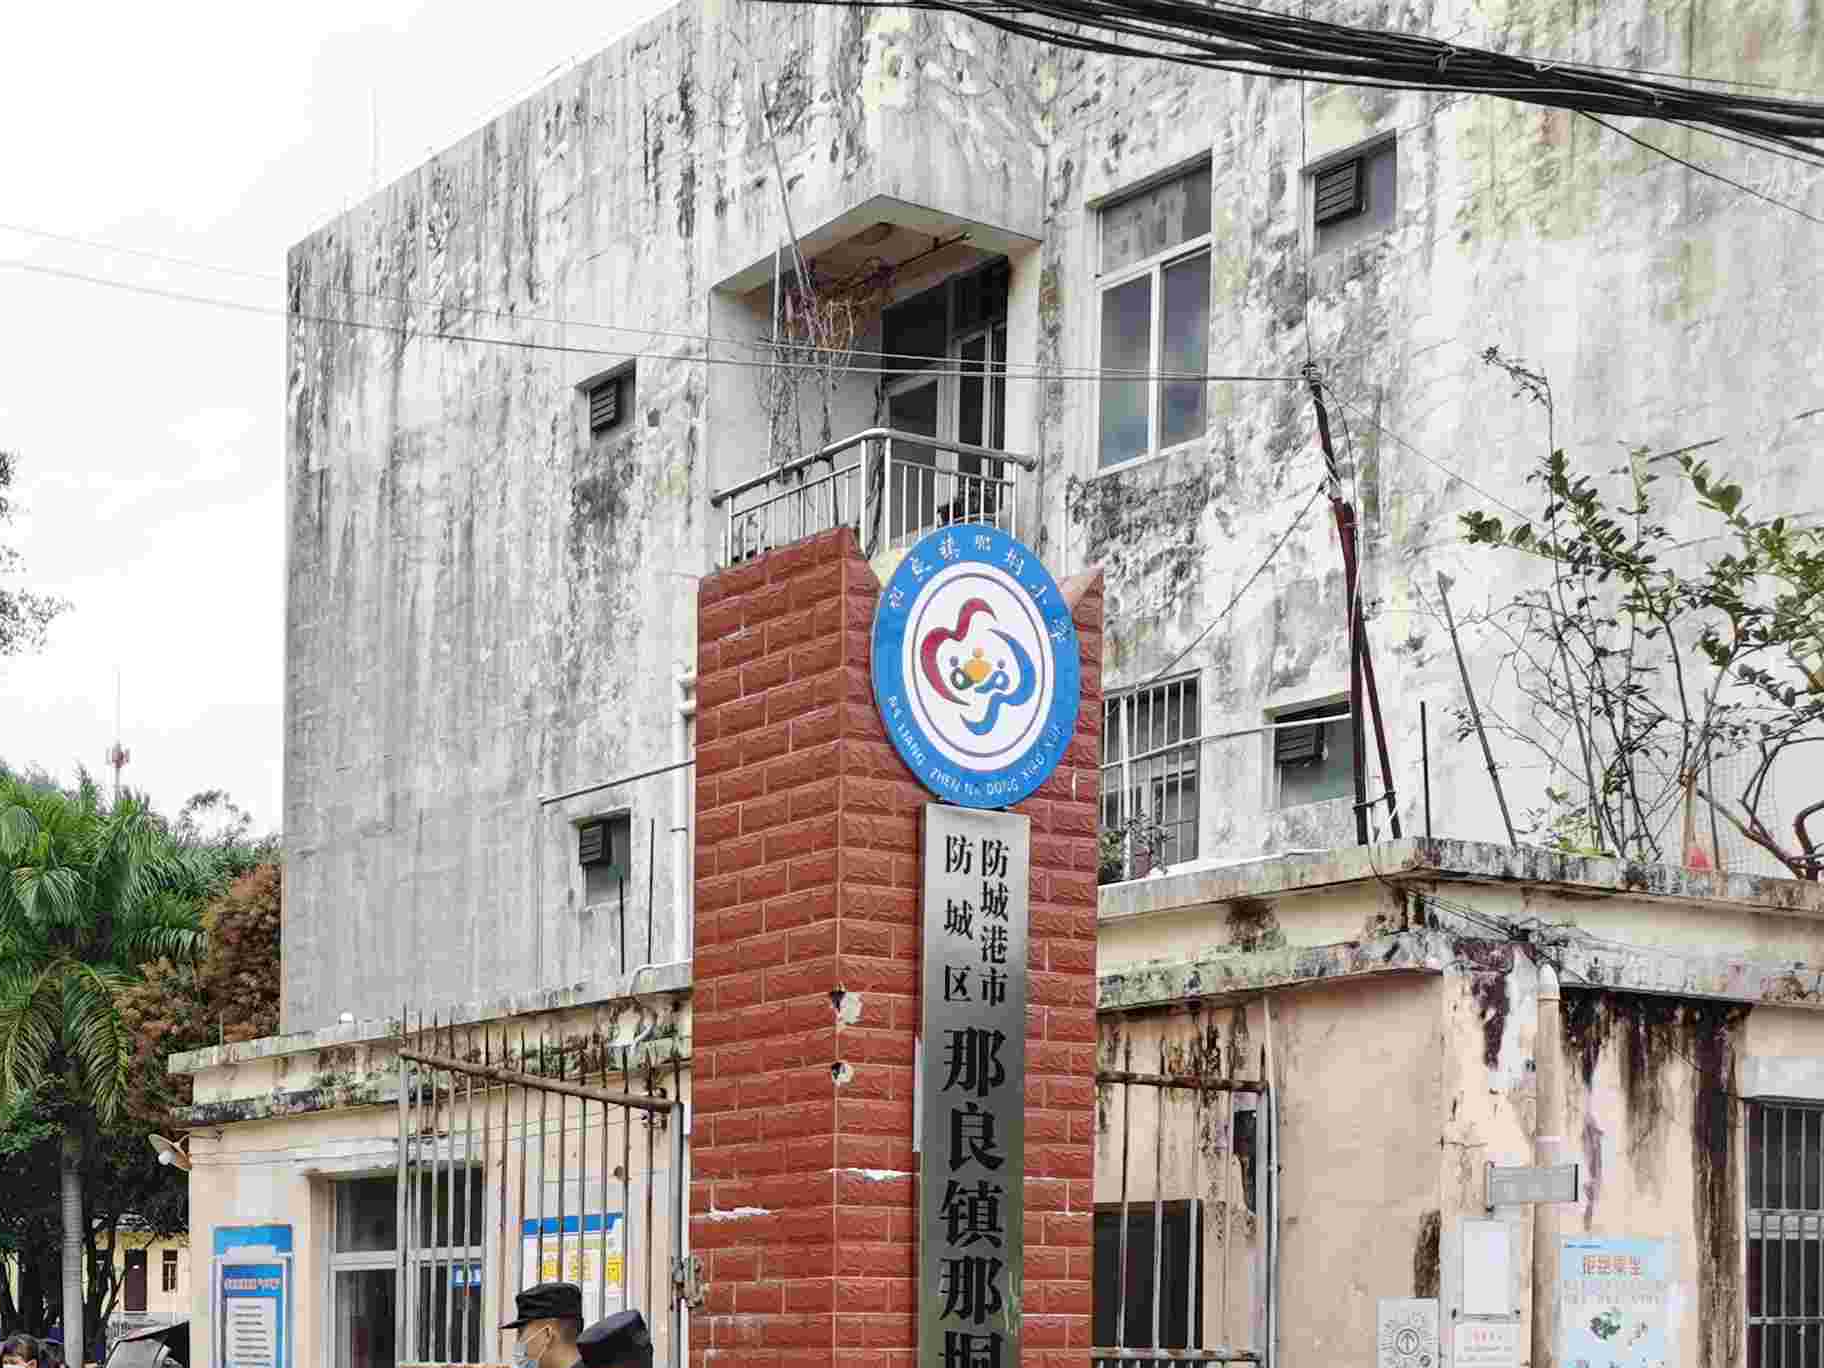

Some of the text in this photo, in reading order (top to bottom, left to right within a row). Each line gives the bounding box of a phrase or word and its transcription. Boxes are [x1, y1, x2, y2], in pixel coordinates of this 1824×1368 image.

[943, 833, 974, 1003] 防城区
[979, 836, 1009, 1008] 防城港市
